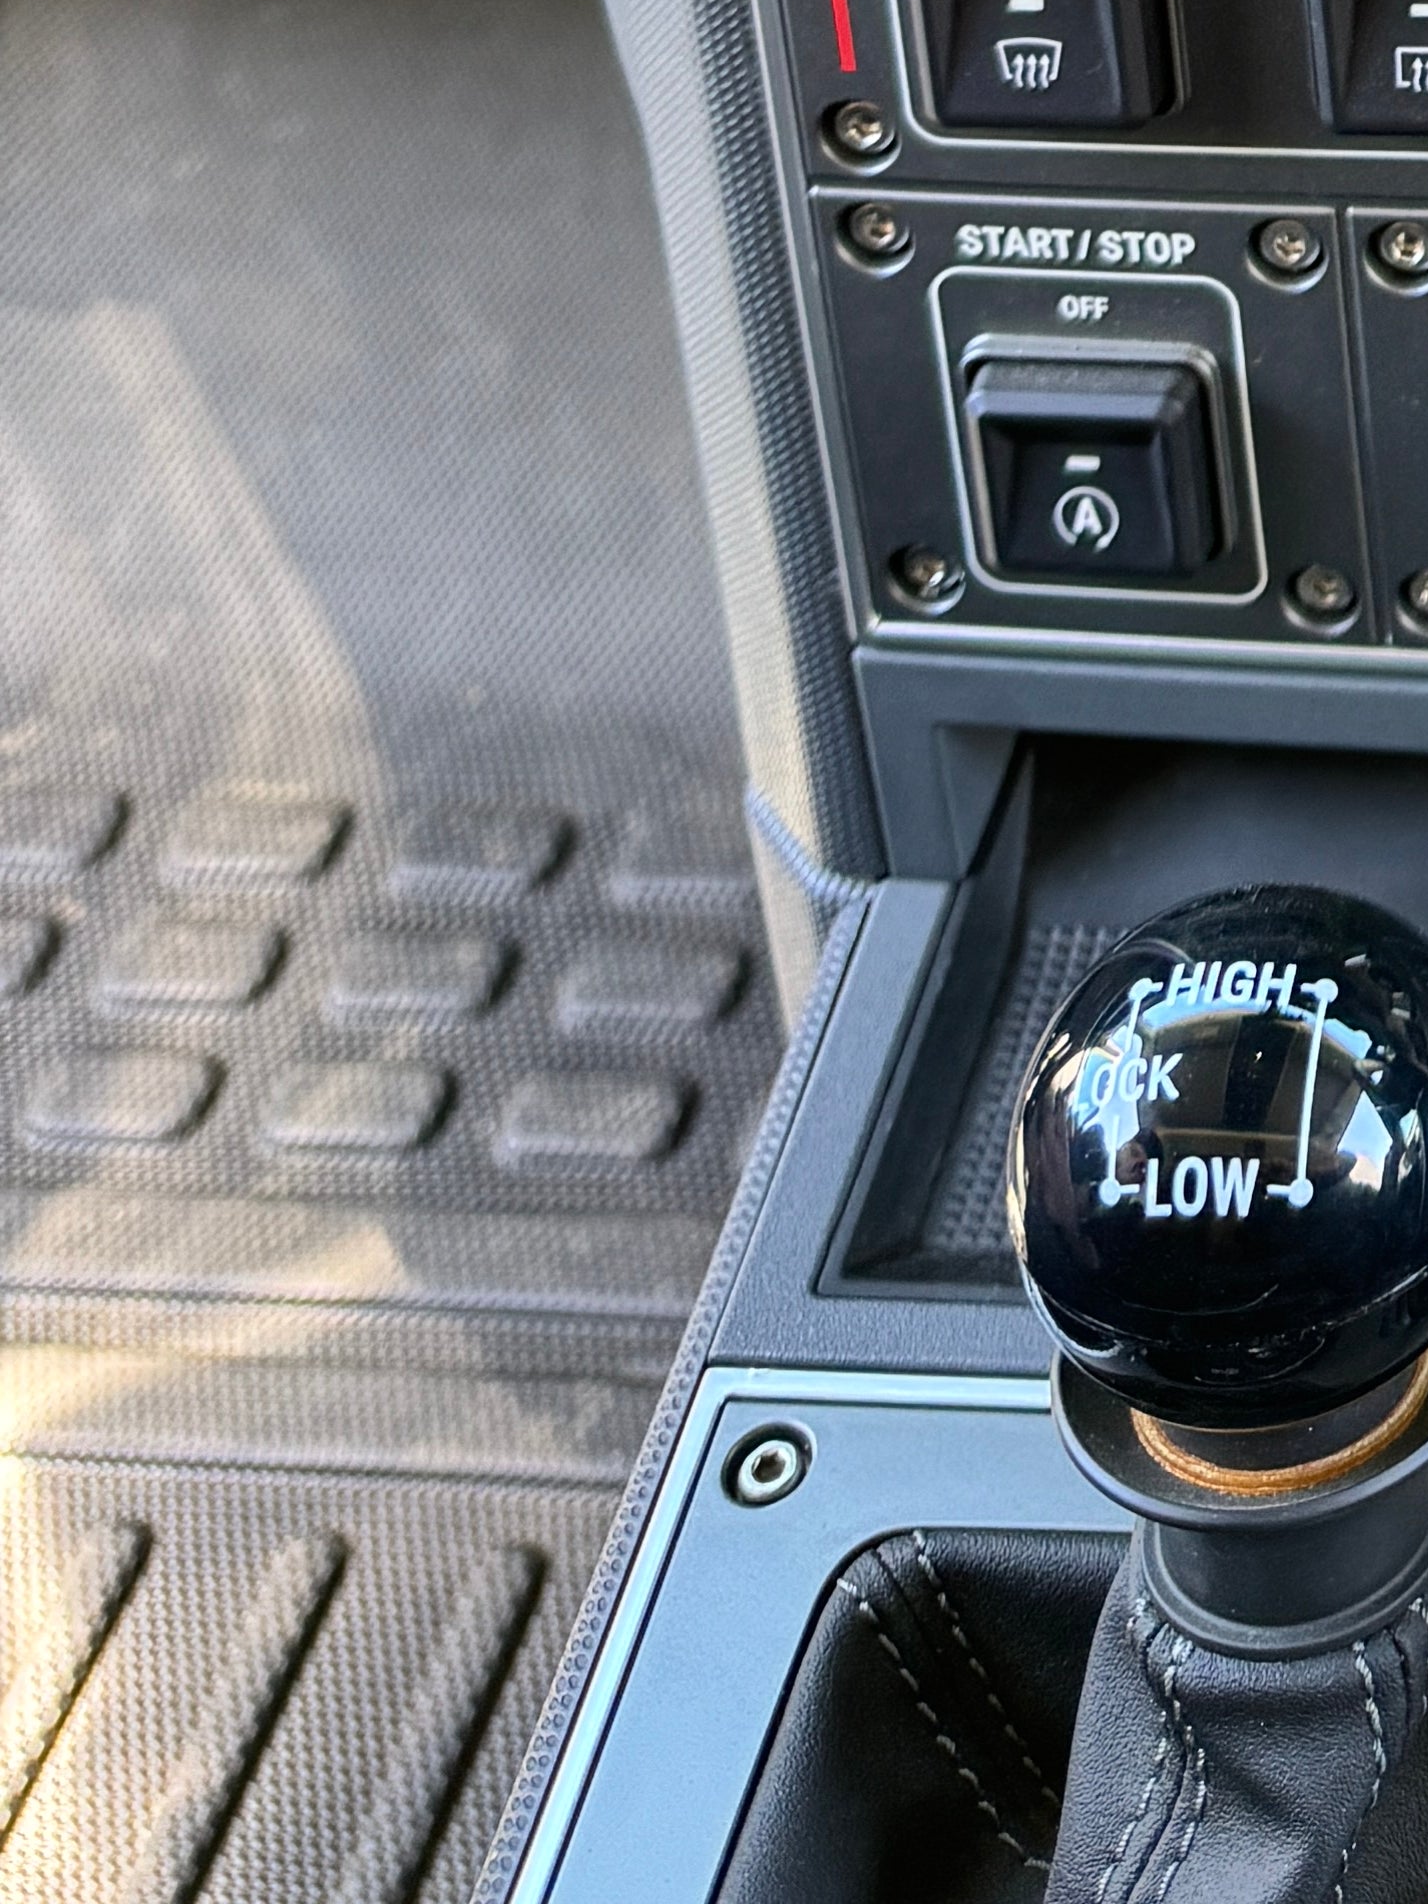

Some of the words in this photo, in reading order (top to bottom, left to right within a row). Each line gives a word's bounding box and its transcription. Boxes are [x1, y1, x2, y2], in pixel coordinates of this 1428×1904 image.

[956, 224, 1074, 260] START
[1097, 230, 1195, 265] STOP
[1058, 295, 1108, 320] OFF
[1166, 960, 1298, 1007] HIGH
[1144, 1156, 1260, 1219] LOW
